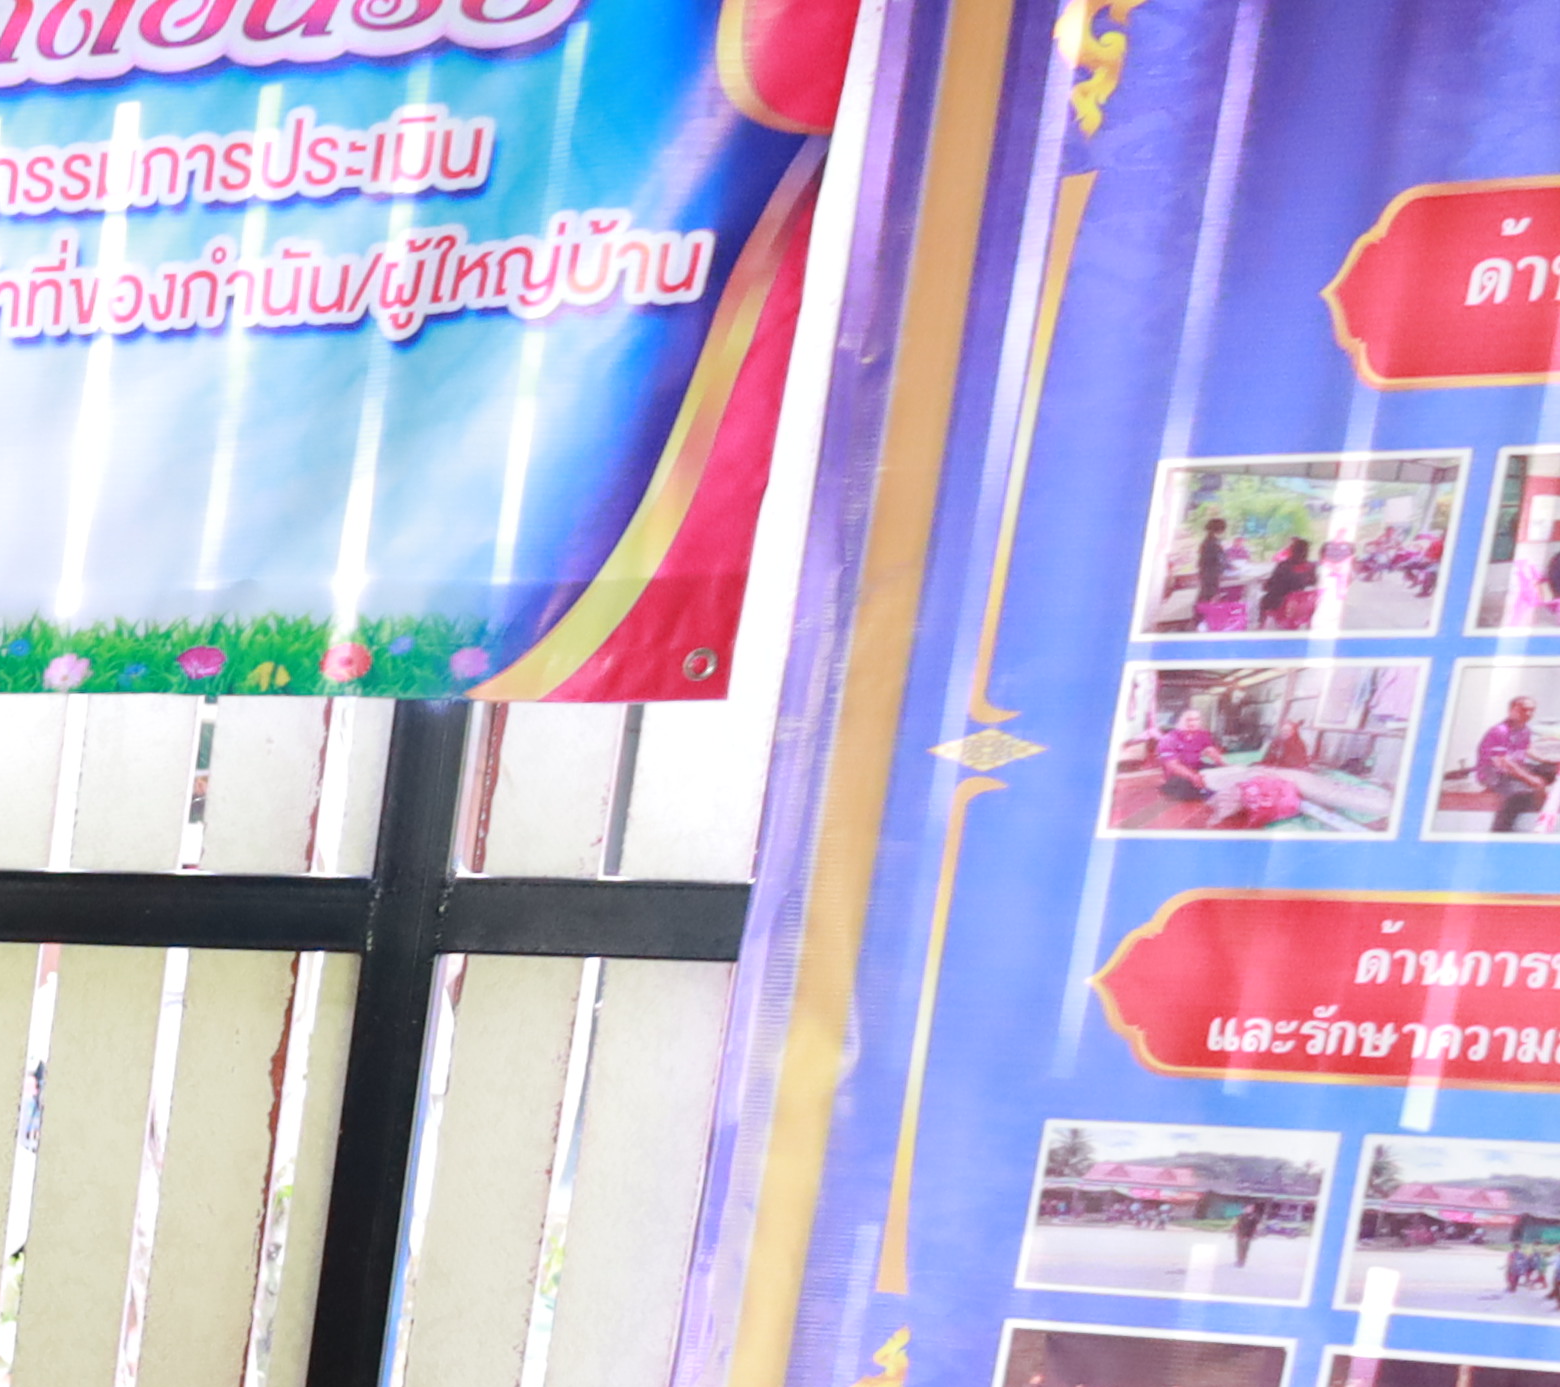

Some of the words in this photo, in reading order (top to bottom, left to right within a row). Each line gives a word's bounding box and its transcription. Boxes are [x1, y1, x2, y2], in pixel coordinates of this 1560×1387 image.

[1463, 216, 1560, 306] ด้า
[1206, 1004, 1560, 1065] และรักษาความ
